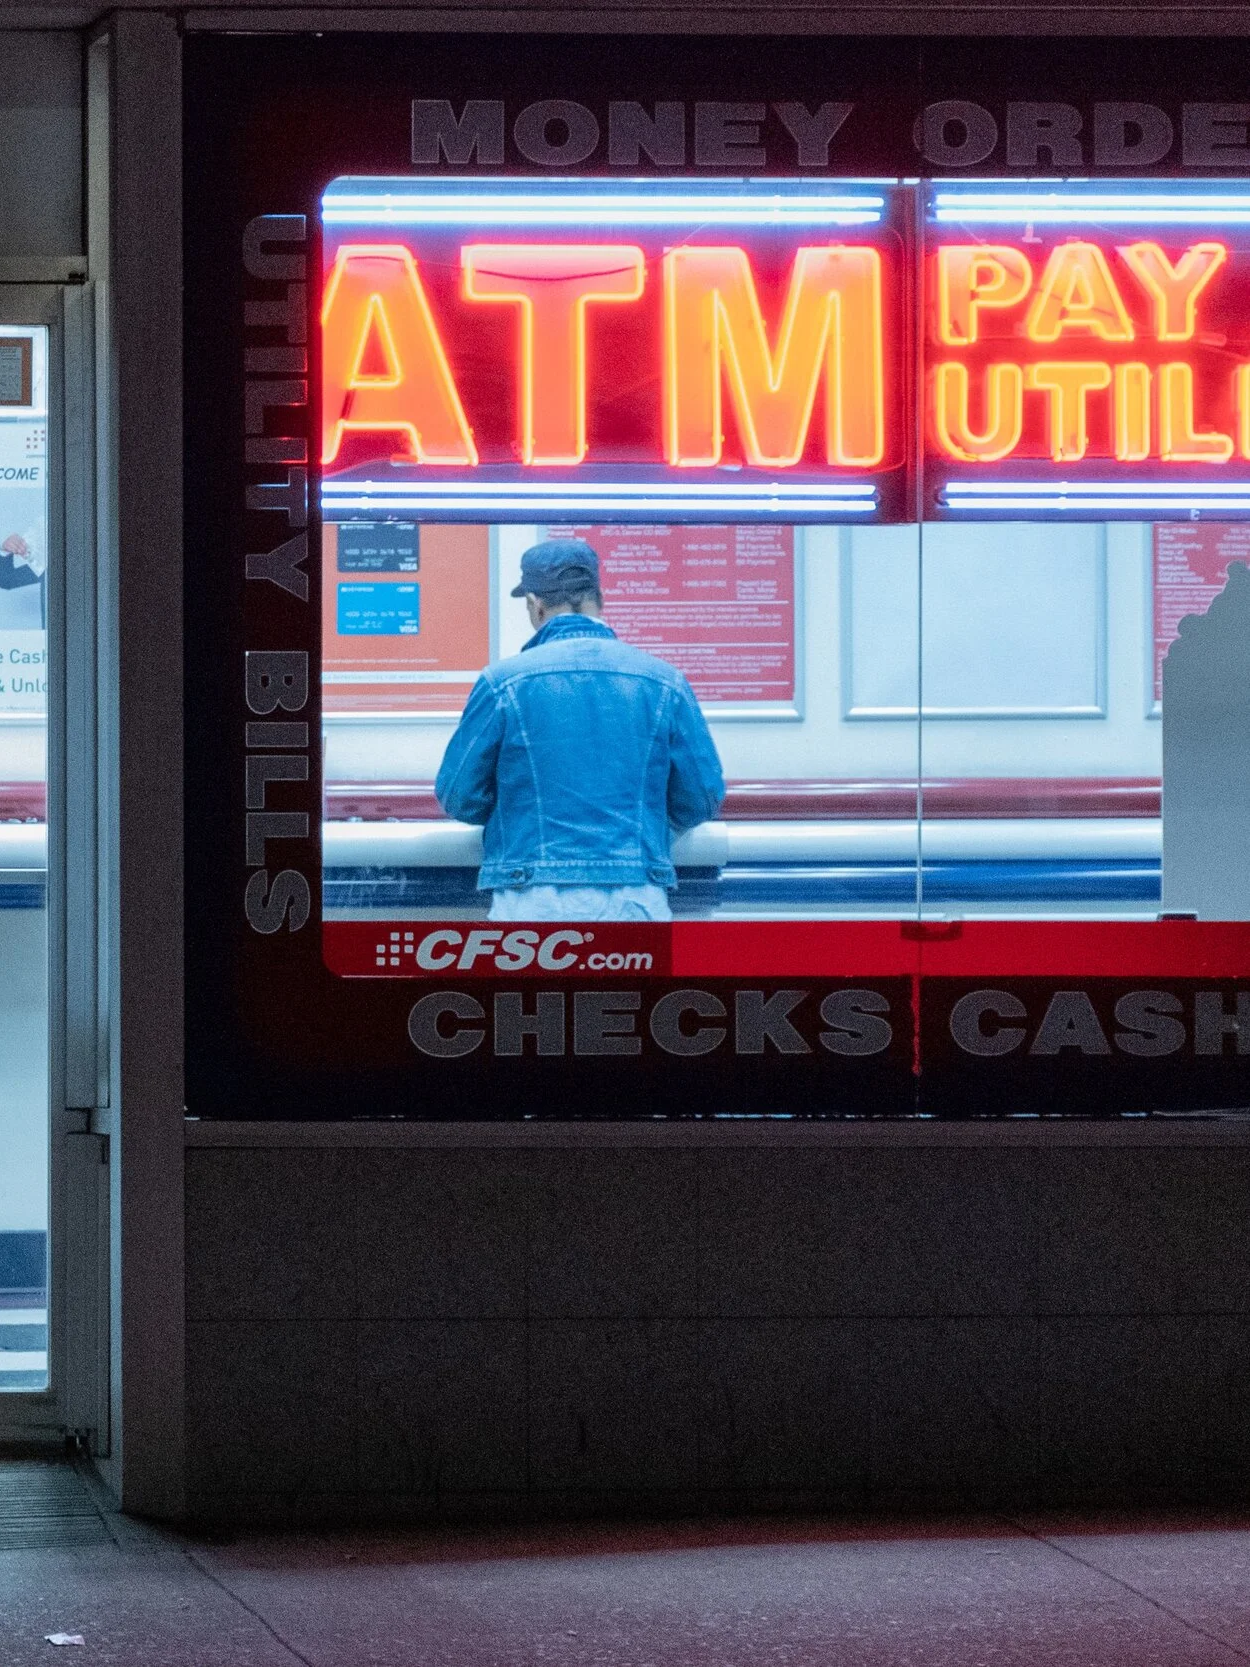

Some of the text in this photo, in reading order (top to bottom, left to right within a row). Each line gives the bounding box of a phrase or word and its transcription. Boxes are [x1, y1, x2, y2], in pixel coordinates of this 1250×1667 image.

[411, 98, 856, 167] MONEY
[937, 241, 1227, 346] PAY
[321, 243, 884, 467] ATM
[241, 213, 311, 934] UTILITY BILLS
[407, 988, 894, 1059] CHECKS
